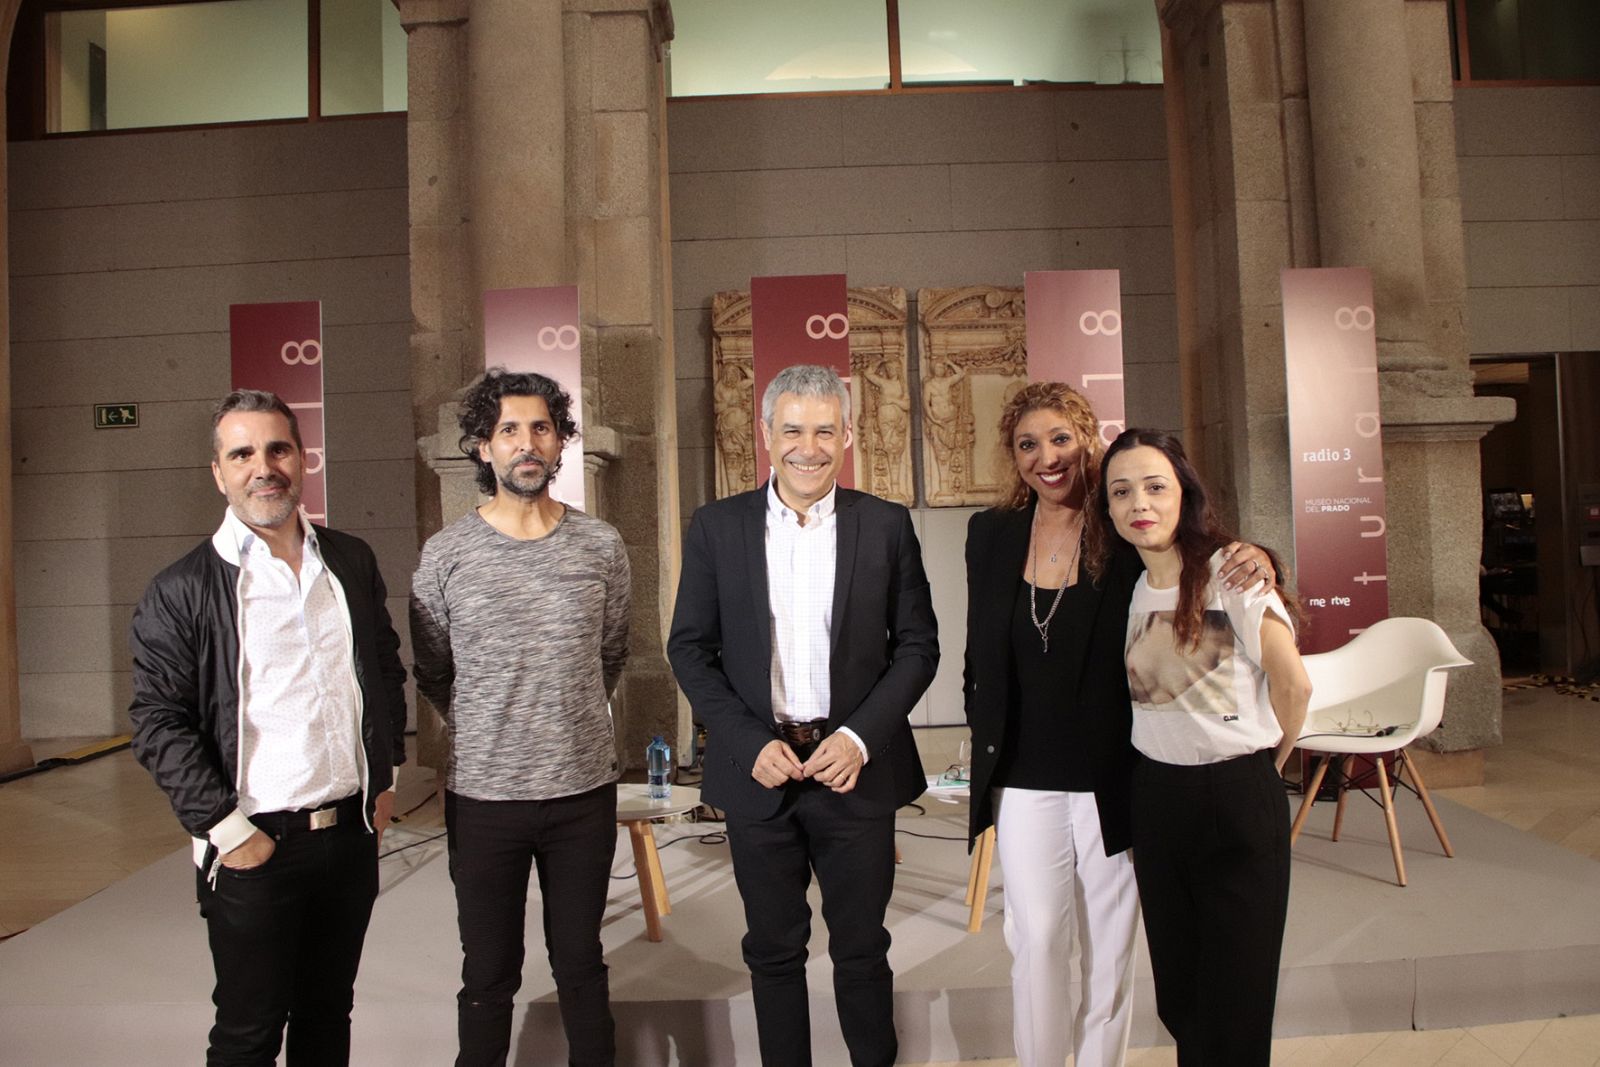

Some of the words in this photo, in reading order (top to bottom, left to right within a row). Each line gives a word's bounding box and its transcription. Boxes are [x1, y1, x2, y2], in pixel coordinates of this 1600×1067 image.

[1303, 448, 1340, 462] radio
[1343, 448, 1352, 461] 3
[1305, 498, 1333, 506] MUSEO
[1333, 496, 1373, 504] NACIONAL
[1331, 596, 1351, 606] rtve
